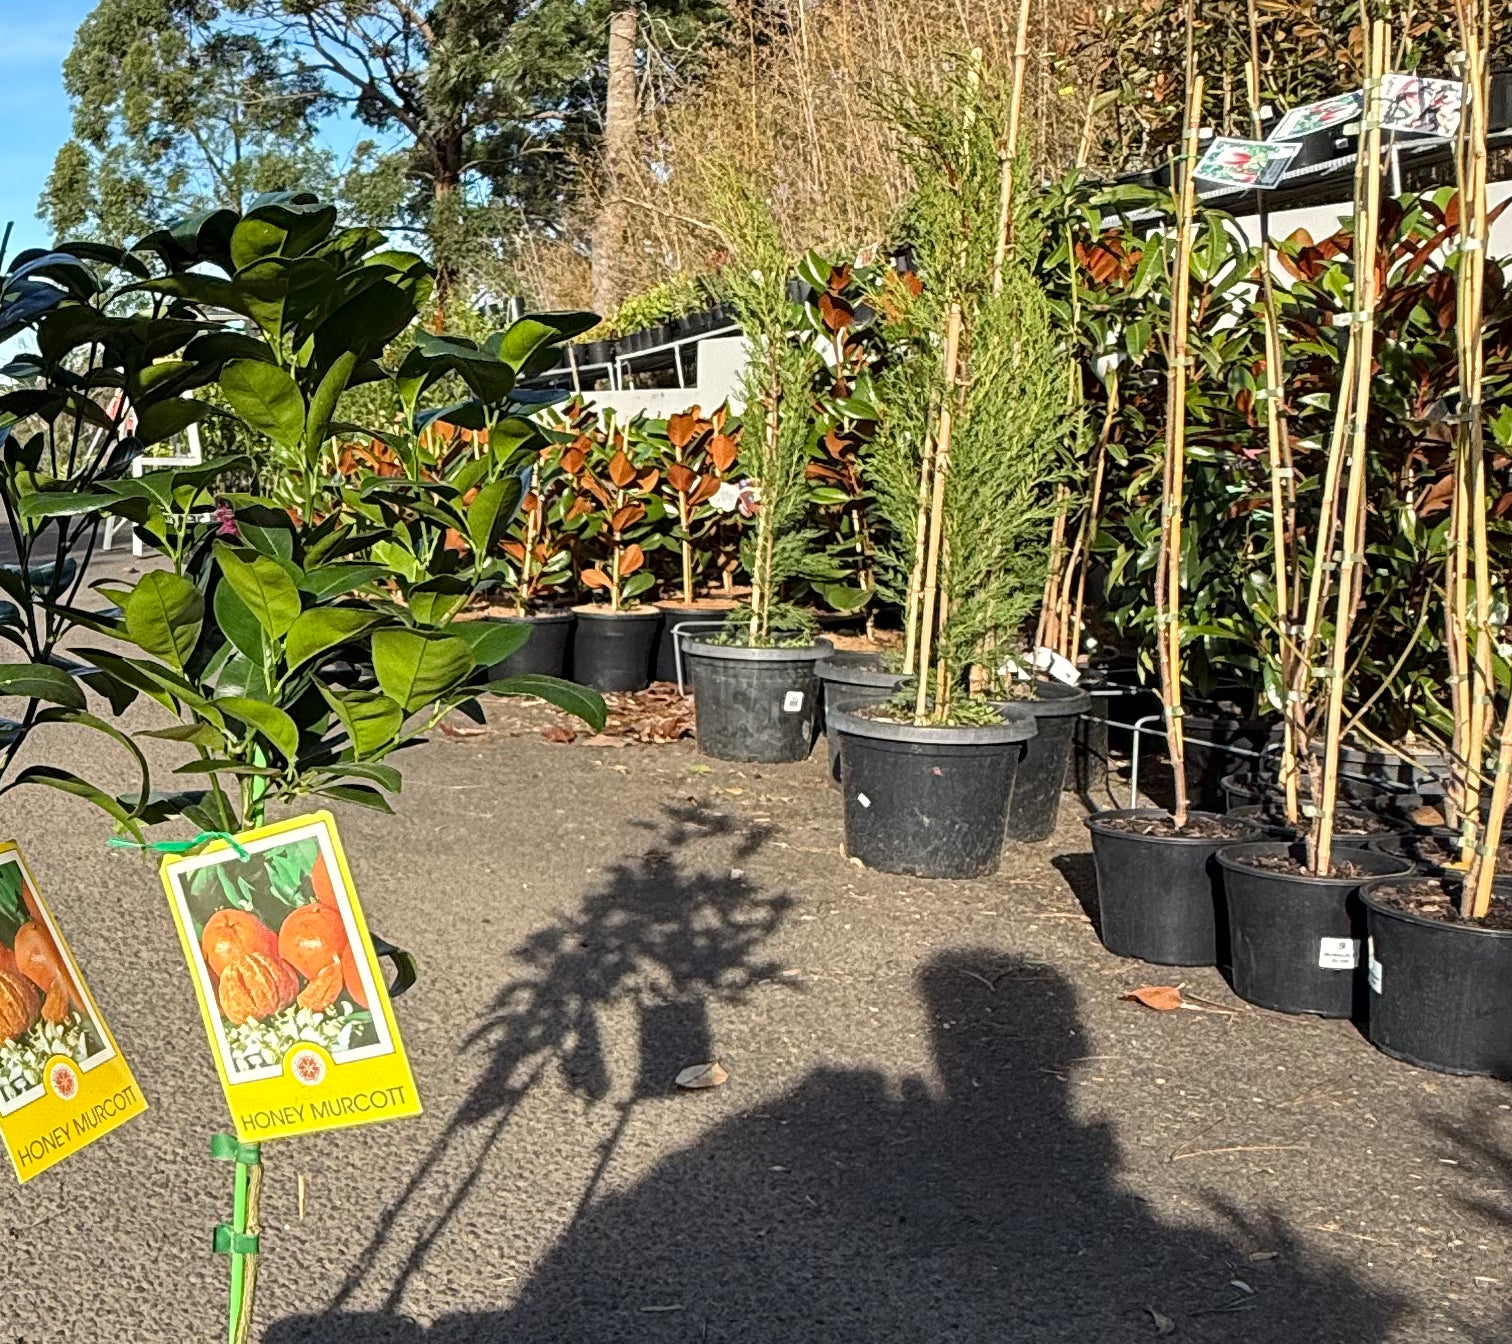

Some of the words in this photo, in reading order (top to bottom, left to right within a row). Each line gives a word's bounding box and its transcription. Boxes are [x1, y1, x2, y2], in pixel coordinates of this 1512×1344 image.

[18, 1122, 72, 1167] HONEY
[72, 1085, 137, 1136] MURCOTT
[241, 1104, 305, 1132] HONEY
[310, 1086, 406, 1121] MURCOTT
